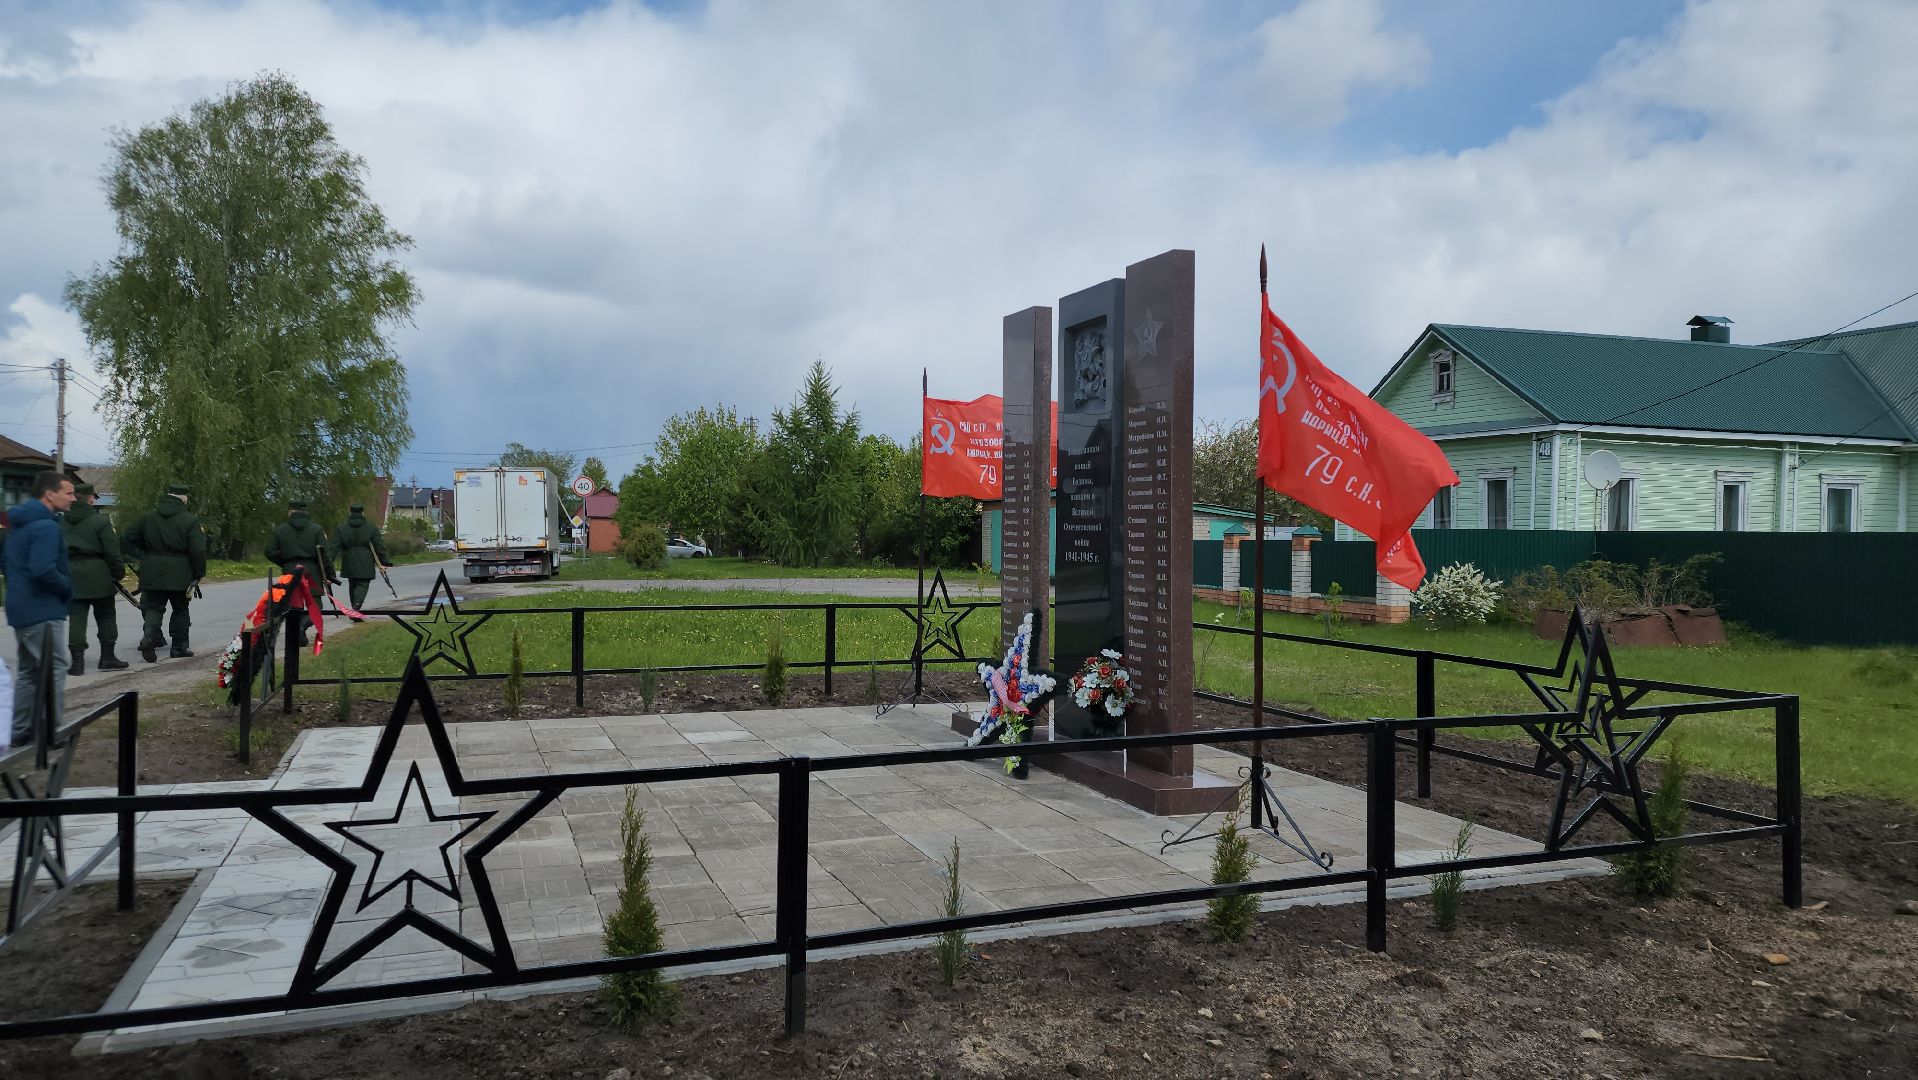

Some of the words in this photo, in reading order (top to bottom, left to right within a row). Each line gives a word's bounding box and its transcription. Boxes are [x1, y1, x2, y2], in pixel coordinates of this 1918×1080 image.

[1540, 442, 1551, 456] 48
[1305, 444, 1343, 484] 79
[979, 464, 997, 485] 79
[577, 482, 590, 491] 40
[1065, 551, 1094, 563] 1941-1945
